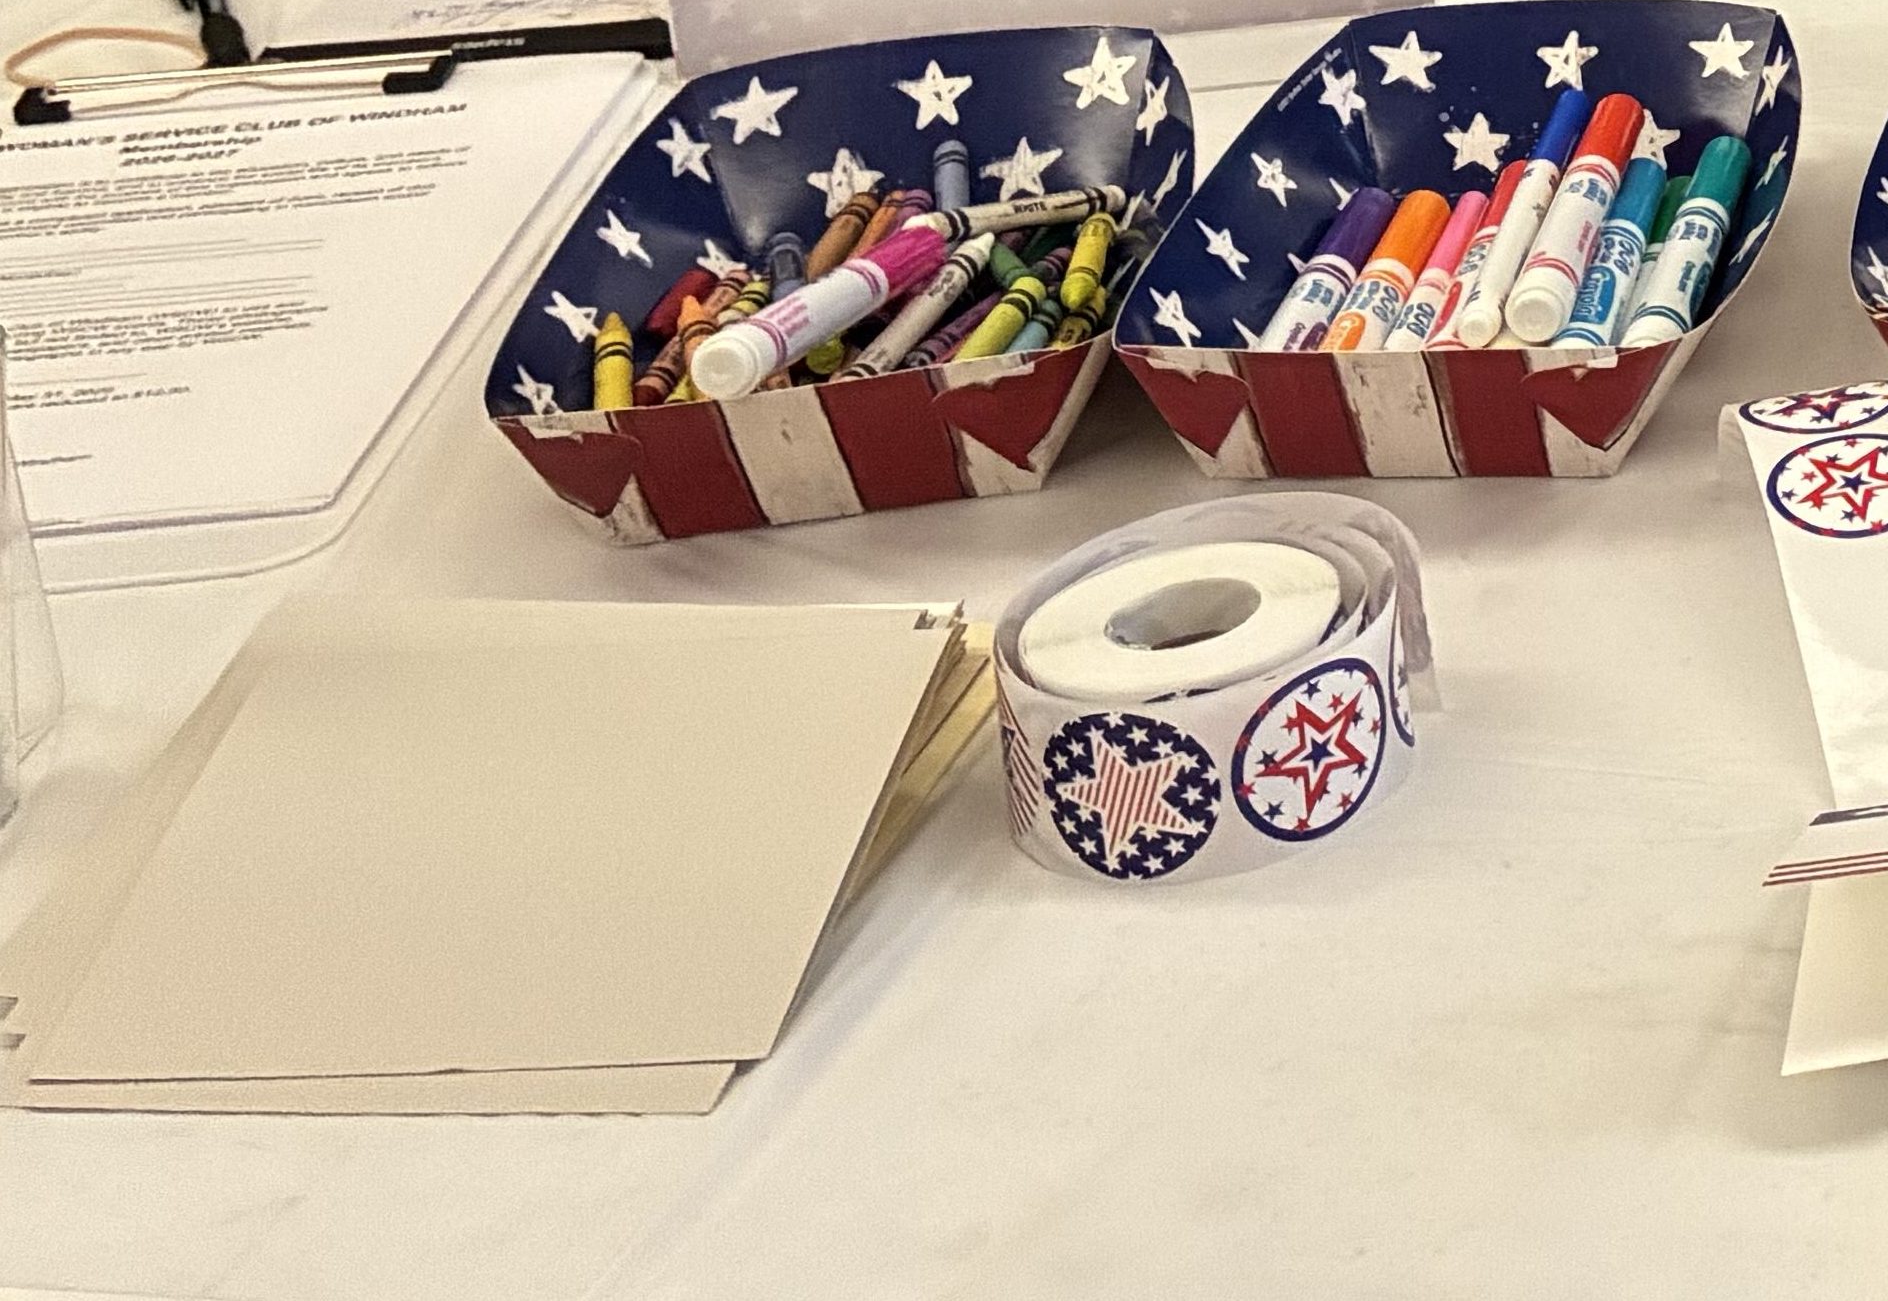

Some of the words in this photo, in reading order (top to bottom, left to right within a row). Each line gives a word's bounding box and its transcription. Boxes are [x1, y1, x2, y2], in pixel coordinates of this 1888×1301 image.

[117, 123, 228, 142] SERVICE
[233, 116, 300, 132] CLUB
[306, 113, 343, 128] OF
[349, 101, 468, 122] WINDHAM
